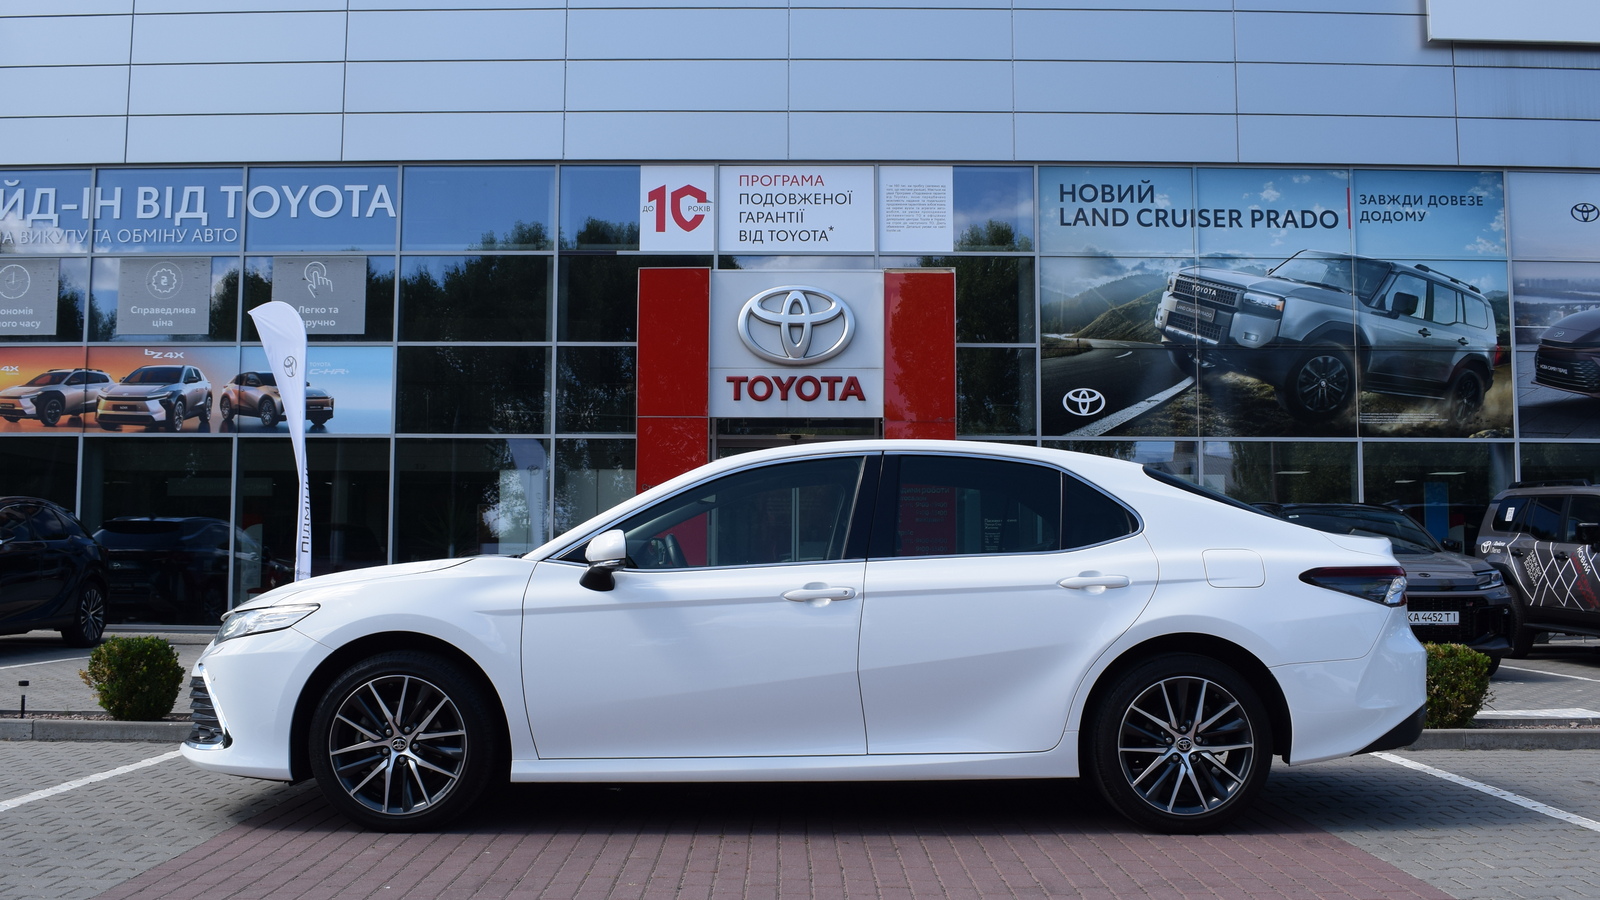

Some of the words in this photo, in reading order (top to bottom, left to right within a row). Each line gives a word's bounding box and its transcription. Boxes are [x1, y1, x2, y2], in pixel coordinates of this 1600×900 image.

[739, 174, 825, 187] ПРОГРАМА
[739, 190, 853, 207] ПОДОВЖЕНОЇ
[1059, 179, 1155, 204] НОВИЙ
[137, 186, 208, 226] ВІД
[220, 184, 396, 219] TOYOTA
[1359, 194, 1423, 208] ЗАВЖДИ
[1427, 195, 1484, 208] ДОВЕЗЕ
[642, 205, 655, 213] ДО
[739, 208, 806, 223] ГАРАНТІЇ
[1060, 207, 1129, 228] LAND
[1136, 208, 1243, 229] CRUISER
[1251, 209, 1339, 230] PRADO
[1359, 210, 1427, 224] ДОДОМУ
[0, 230, 14, 245] А
[20, 229, 89, 245] ВИКУПУ
[94, 229, 112, 243] ТА
[117, 228, 187, 243] ОБМІНУ
[191, 228, 238, 242] АВТО
[739, 230, 764, 244] ВІД
[1191, 284, 1217, 297] TOYOTA
[0, 306, 33, 315] ономія
[130, 305, 196, 317] Справедлива
[298, 305, 326, 315] Легко
[328, 307, 339, 315] та
[19, 320, 41, 330] часу
[152, 318, 173, 330] ціна
[726, 375, 867, 402] TOYOTA
[1577, 545, 1591, 575] НОВИЙ
[1421, 612, 1443, 622] 4452
